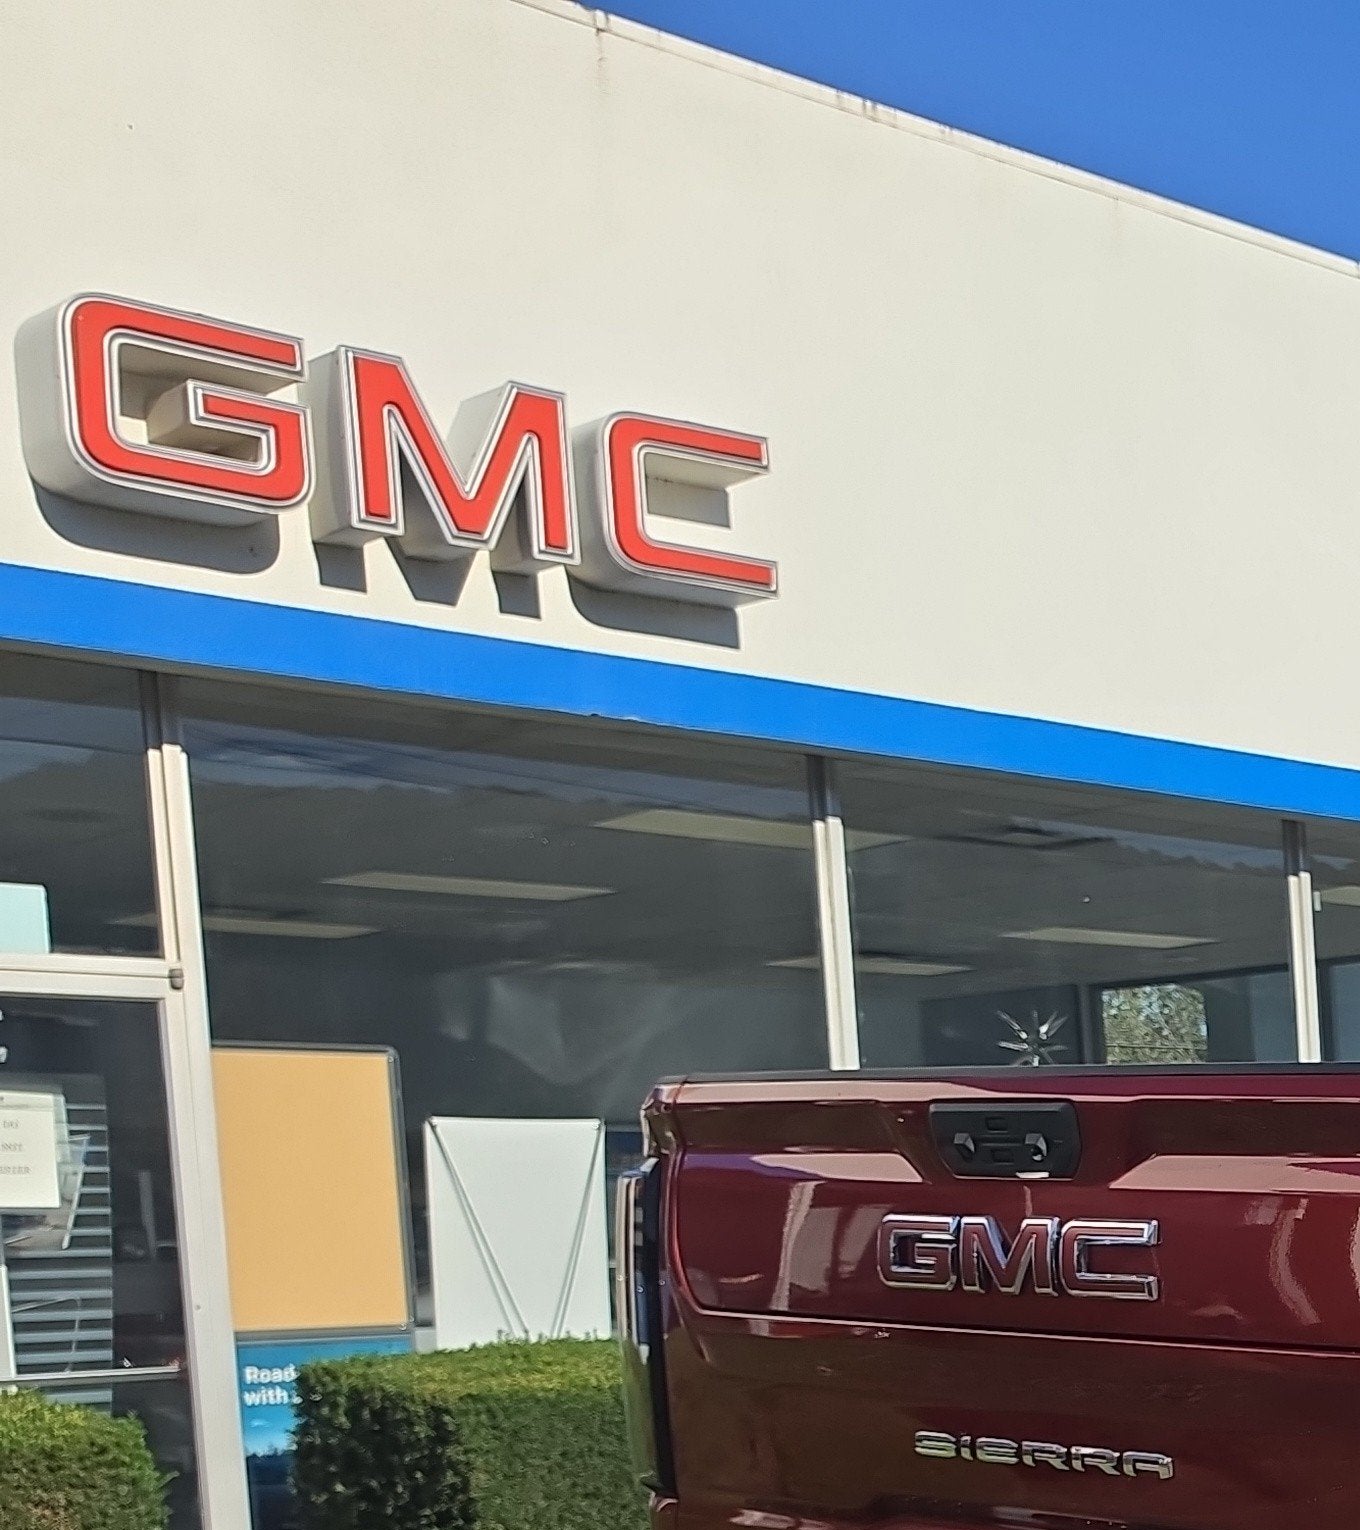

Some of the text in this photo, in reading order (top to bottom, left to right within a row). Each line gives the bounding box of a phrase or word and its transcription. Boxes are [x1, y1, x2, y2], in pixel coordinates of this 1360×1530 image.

[48, 291, 778, 595] GMC
[877, 1214, 1160, 1301] GMC
[243, 1385, 289, 1406] with
[914, 1430, 1174, 1480] SIERRA
